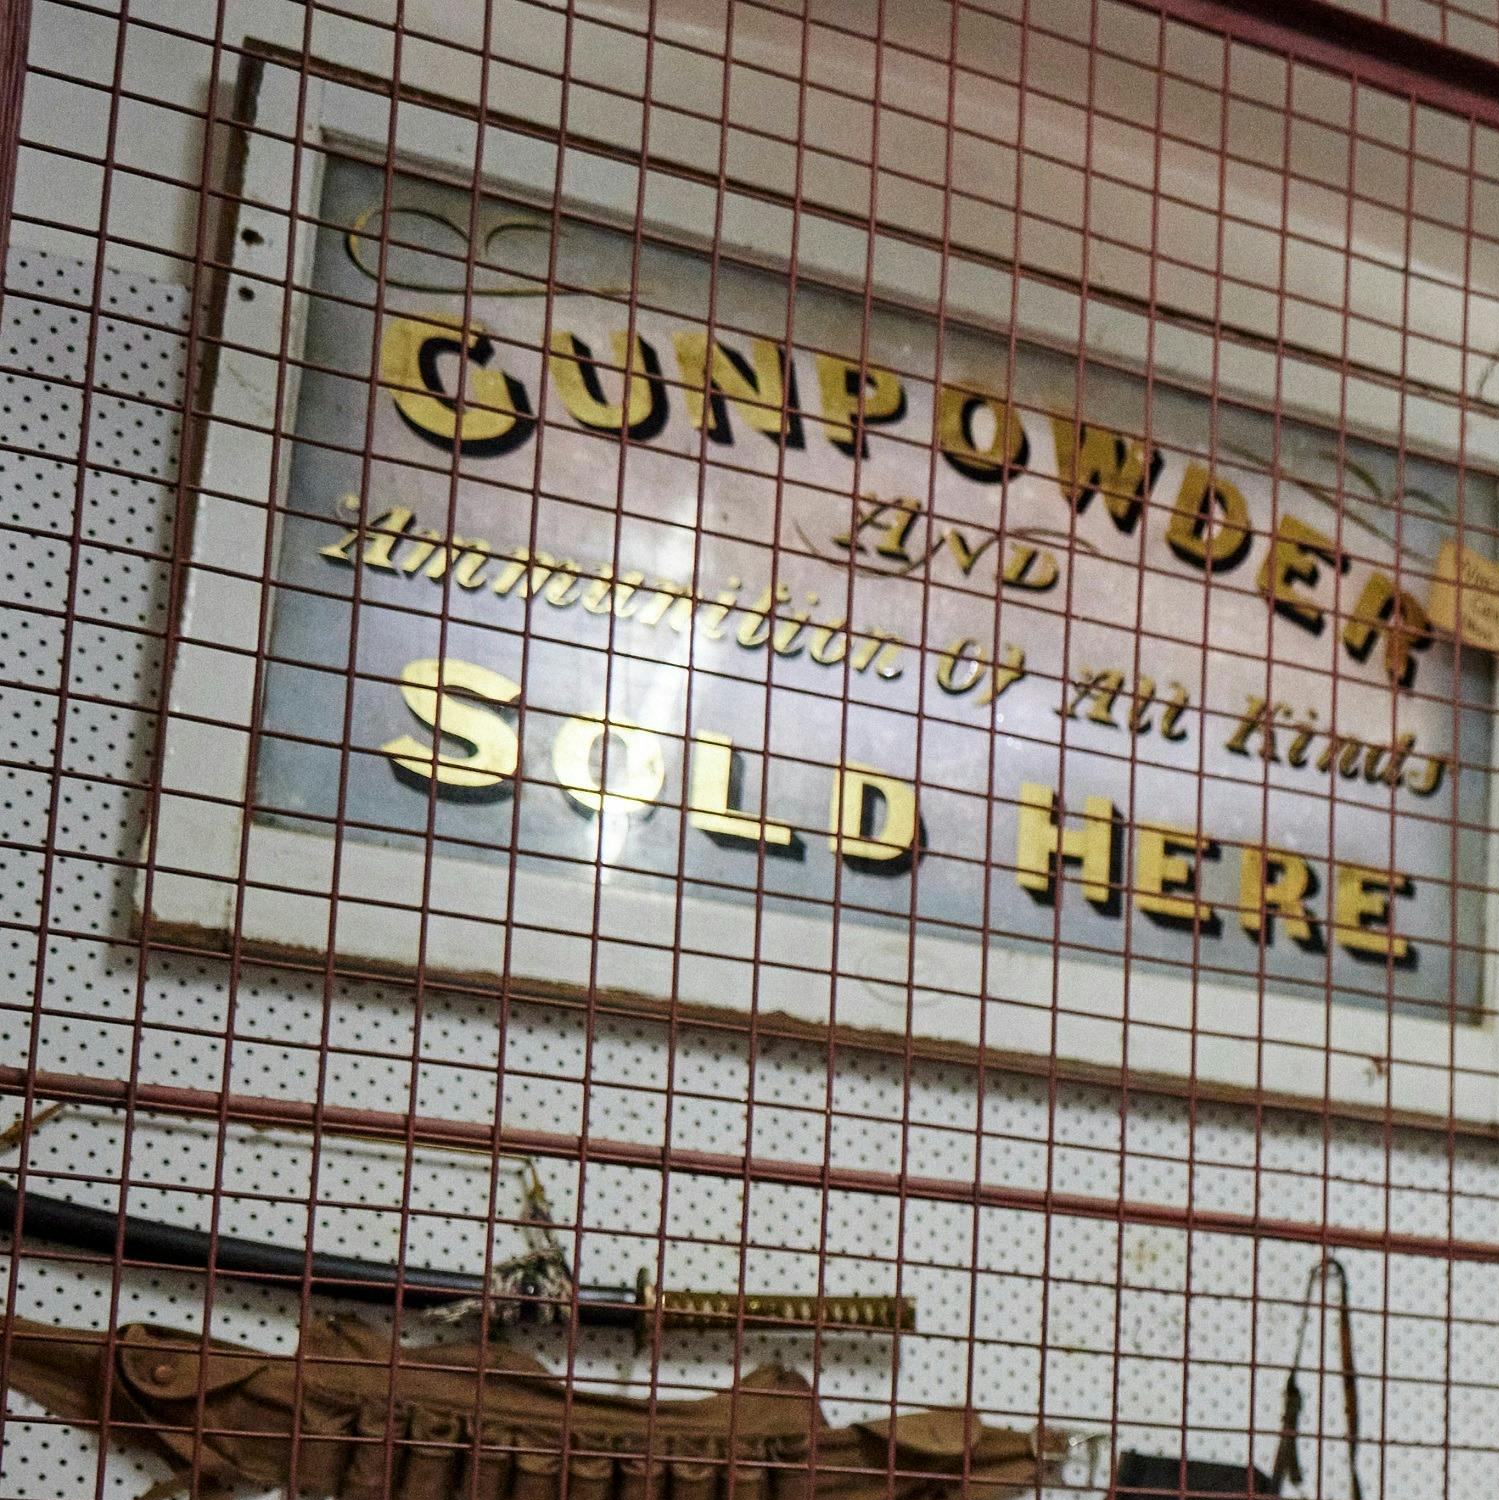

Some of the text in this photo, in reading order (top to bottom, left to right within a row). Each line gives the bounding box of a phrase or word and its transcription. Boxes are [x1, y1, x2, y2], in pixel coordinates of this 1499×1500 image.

[319, 496, 905, 681] Ammunition
[1053, 662, 1191, 743] All
[1224, 694, 1455, 799] Kinds
[380, 312, 1438, 688] GUNPOWDER
[381, 657, 1419, 971] SOLD HERE
